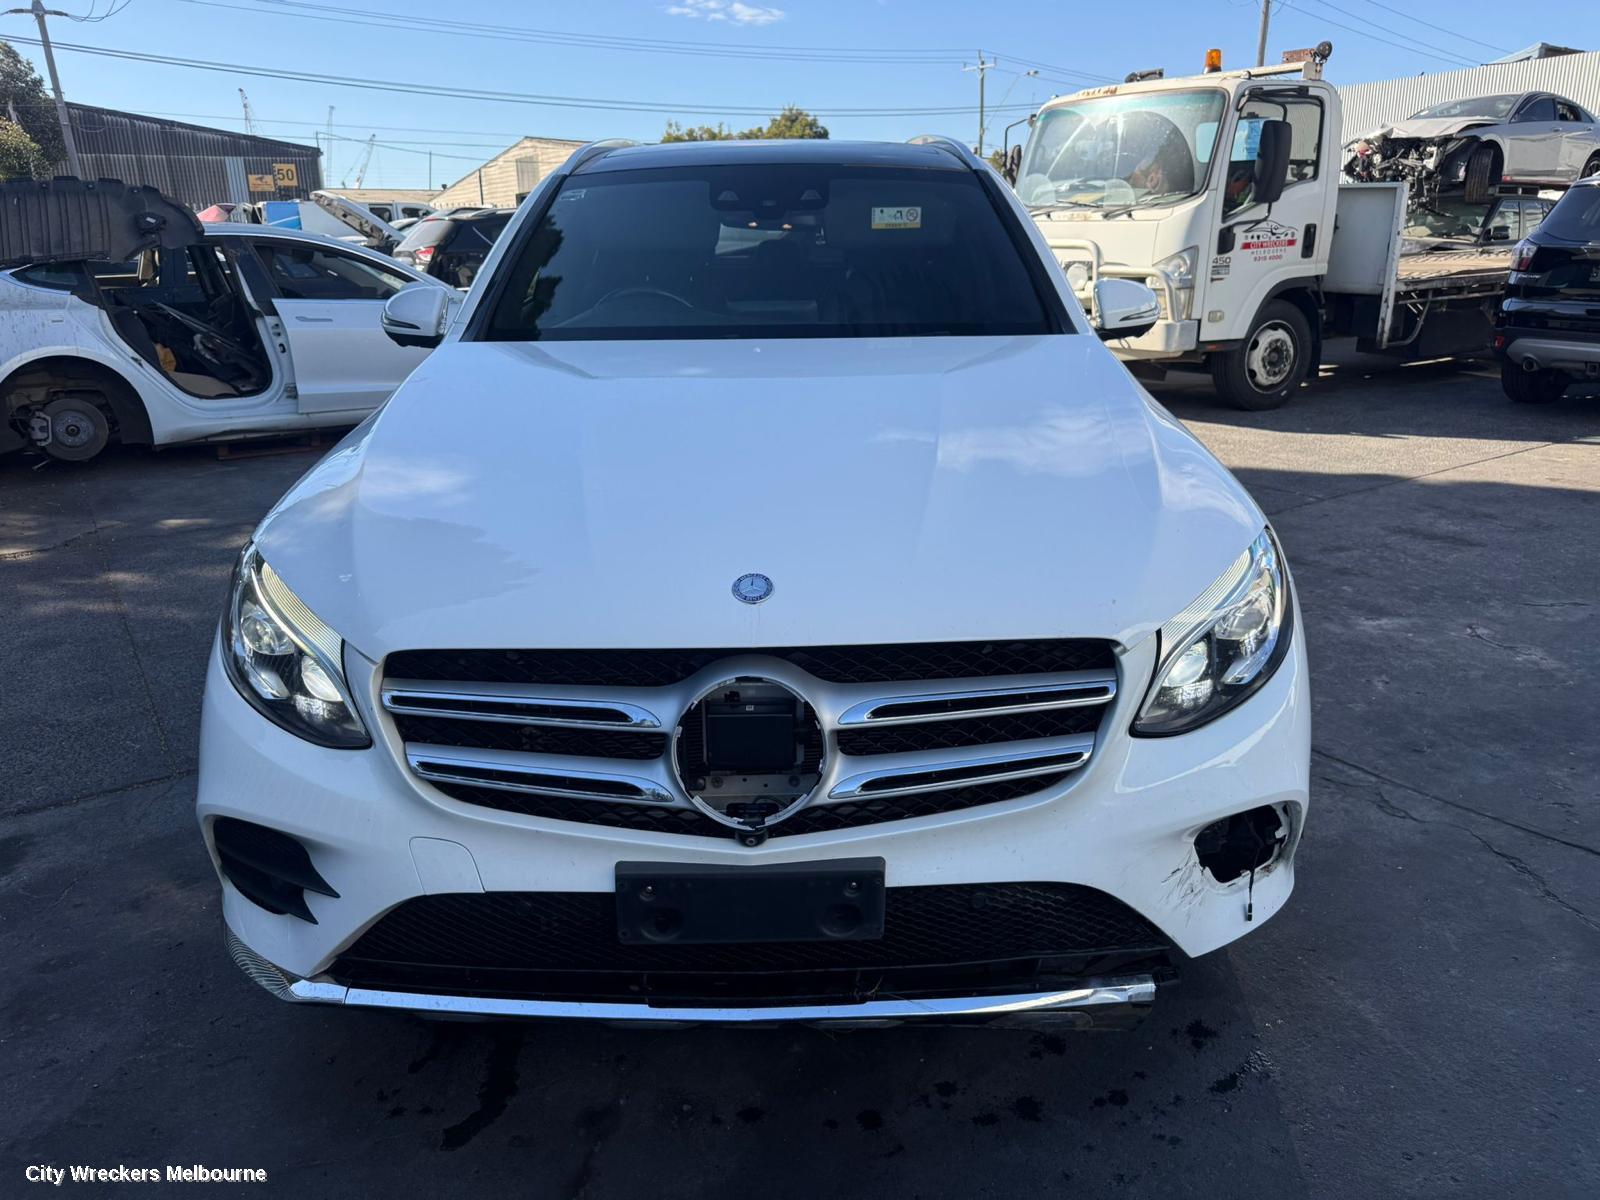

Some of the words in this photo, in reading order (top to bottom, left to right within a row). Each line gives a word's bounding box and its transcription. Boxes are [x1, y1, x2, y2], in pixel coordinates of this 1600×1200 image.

[277, 168, 294, 181] 50
[1250, 241, 1262, 249] CITY
[1212, 256, 1231, 264] 450
